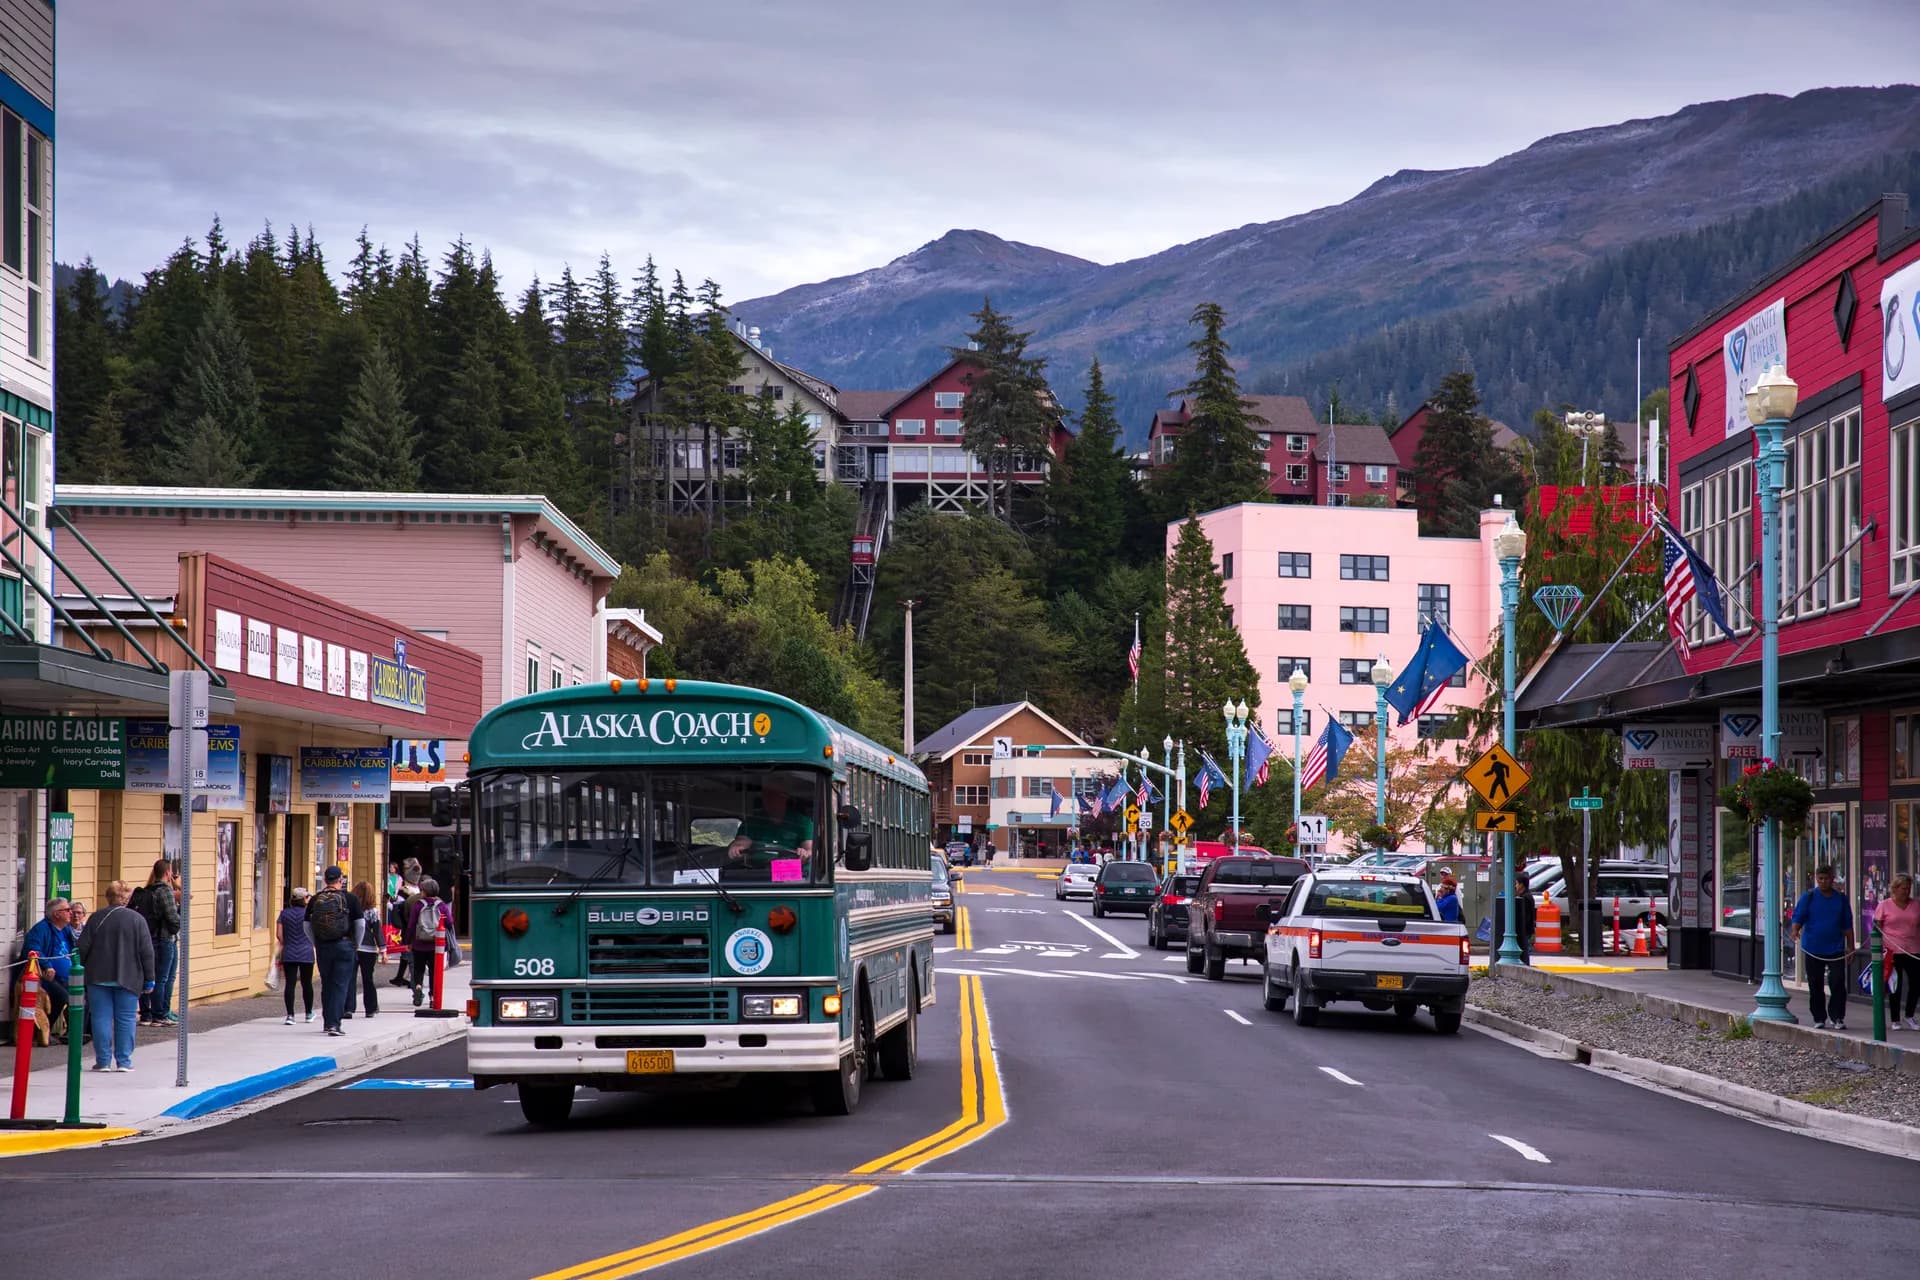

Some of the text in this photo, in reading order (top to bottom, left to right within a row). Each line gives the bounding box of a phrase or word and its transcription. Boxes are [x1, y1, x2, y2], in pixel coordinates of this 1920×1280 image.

[250, 630, 270, 655] RADO
[373, 661, 425, 707] CARIBBEAN GEMS
[2, 720, 119, 741] ARING EAGLE
[522, 710, 752, 750] ALASKA COACH
[1662, 727, 1713, 738] INFINITY
[51, 746, 91, 754] Gemstone
[208, 739, 235, 751] EMS
[1662, 739, 1711, 750] JEWELRY
[1729, 746, 1757, 757] FREE
[6, 758, 36, 767] Jewelry
[63, 759, 120, 767] Ivory Carvings
[304, 758, 386, 768] CARIBBEAN GEMS
[1629, 758, 1655, 768] FREE
[100, 770, 120, 778] Dolls
[51, 841, 68, 862] EAGLE
[588, 911, 709, 922] BLUE BIRD
[514, 958, 555, 976] 508
[631, 1057, 656, 1070] 6165
